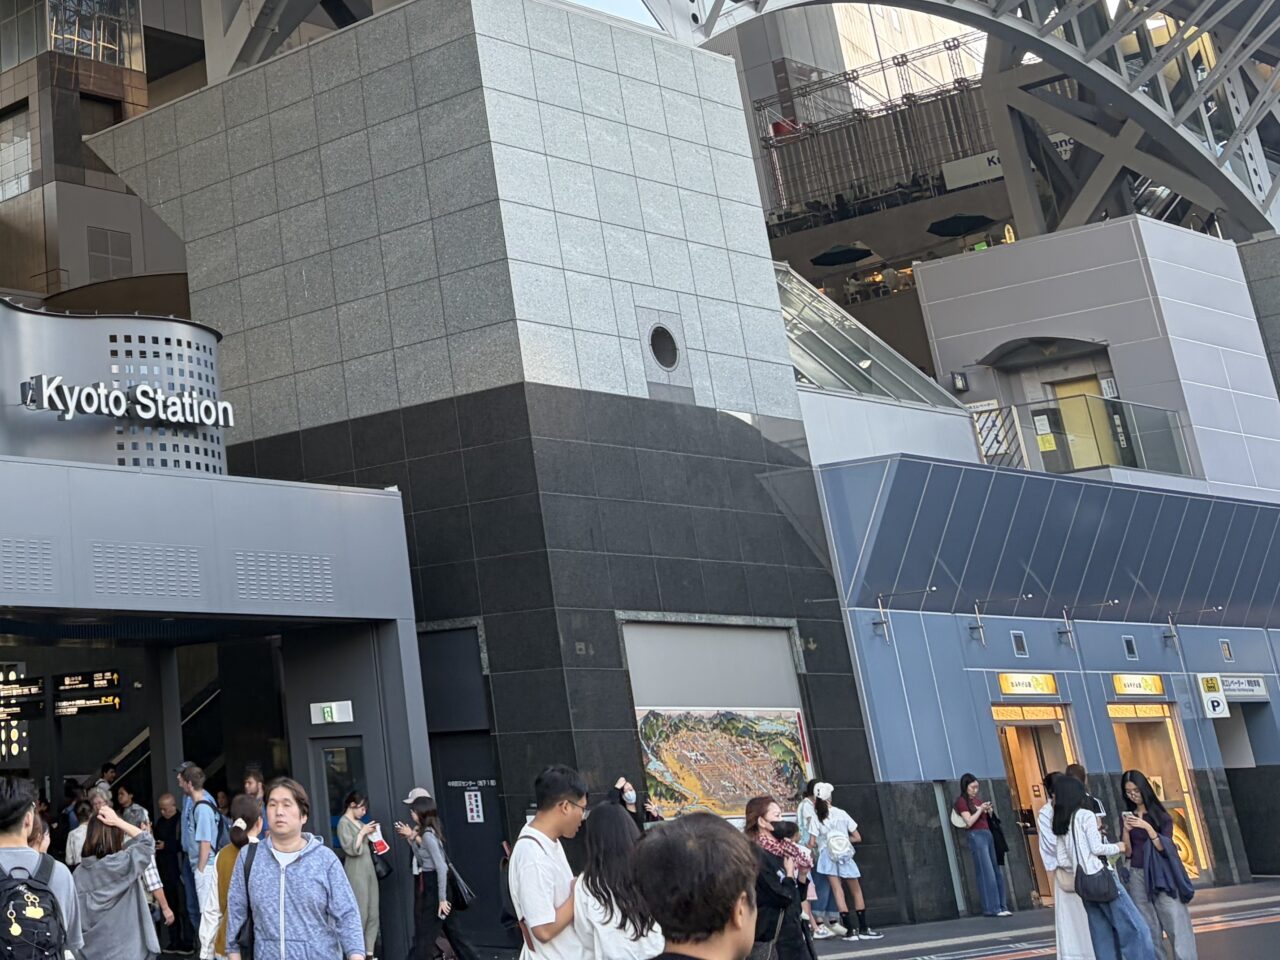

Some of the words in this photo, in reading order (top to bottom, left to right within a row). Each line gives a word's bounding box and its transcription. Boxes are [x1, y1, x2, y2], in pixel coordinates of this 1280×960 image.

[41, 374, 127, 420] Kyoto
[135, 384, 235, 427] Station
[1210, 699, 1221, 712] P
